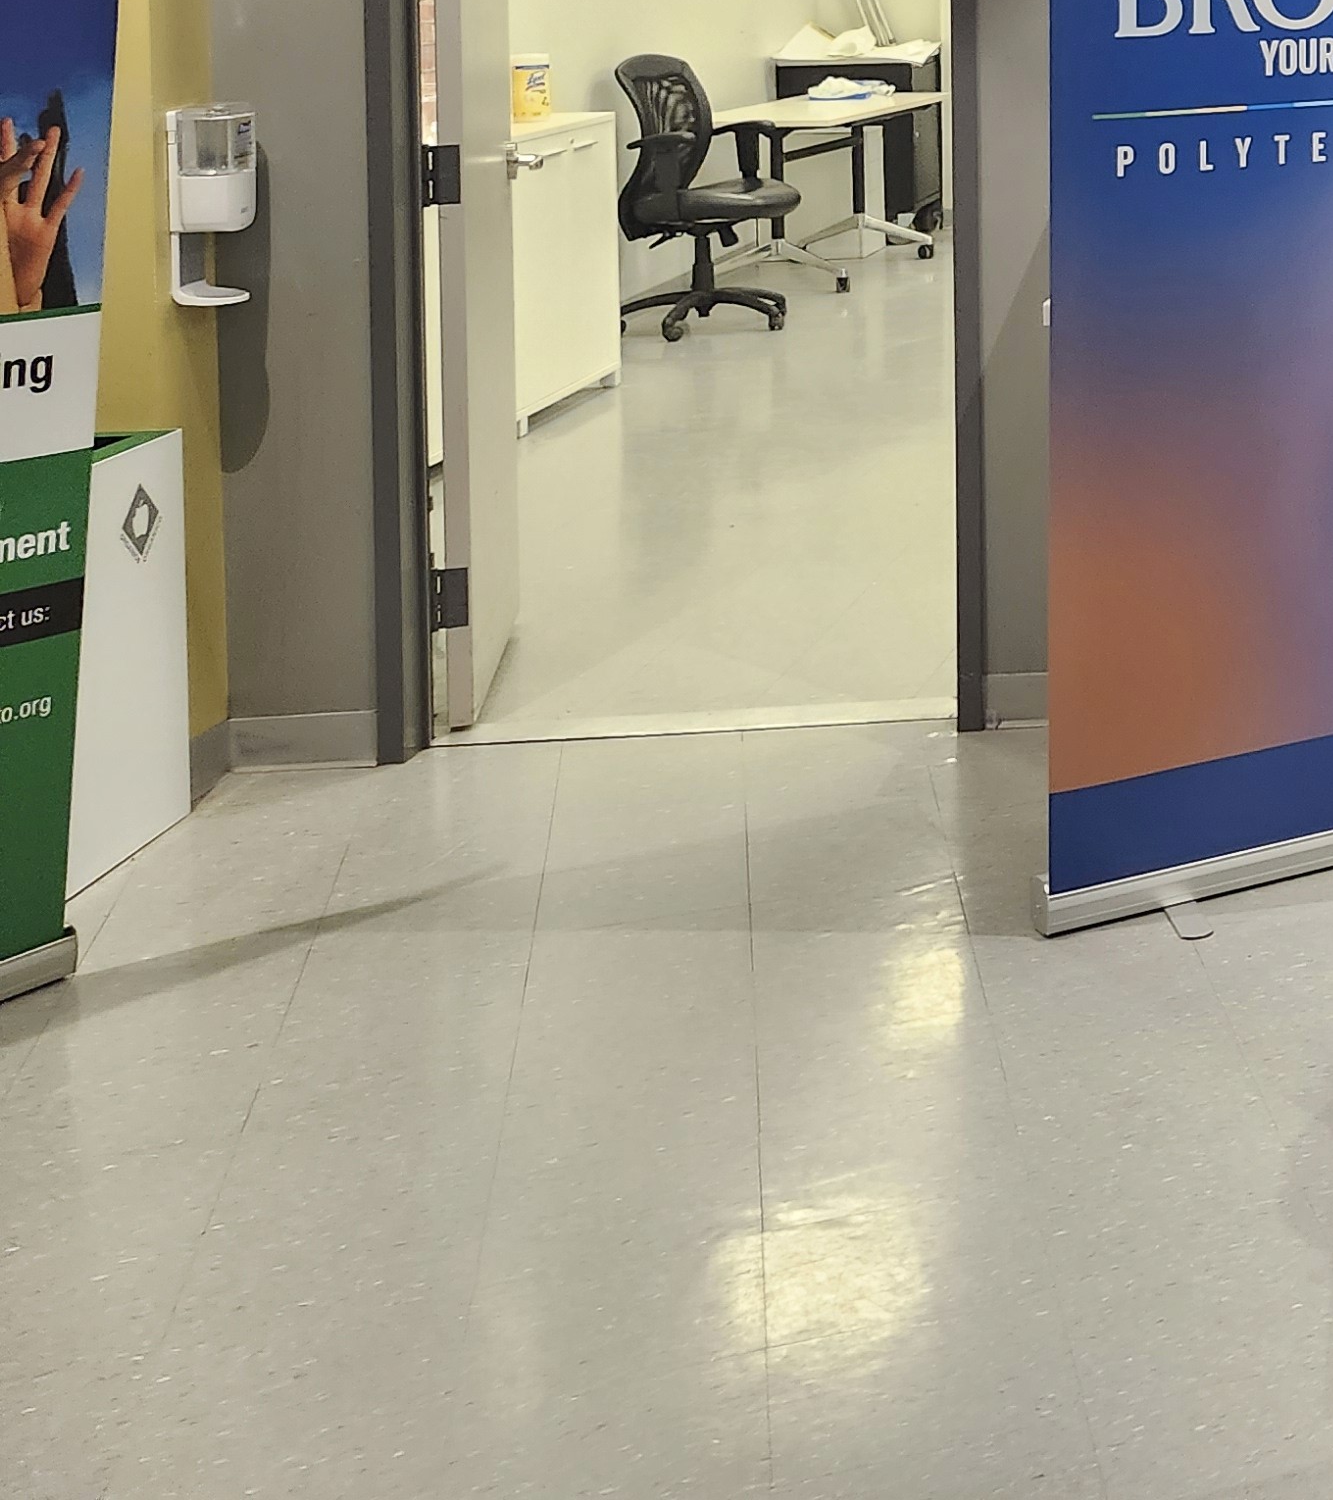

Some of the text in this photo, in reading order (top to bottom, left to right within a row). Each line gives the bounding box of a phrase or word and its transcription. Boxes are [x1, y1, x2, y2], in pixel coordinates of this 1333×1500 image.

[0, 353, 53, 393] ng
[21, 606, 50, 627] us:
[0, 696, 52, 724] o.org
